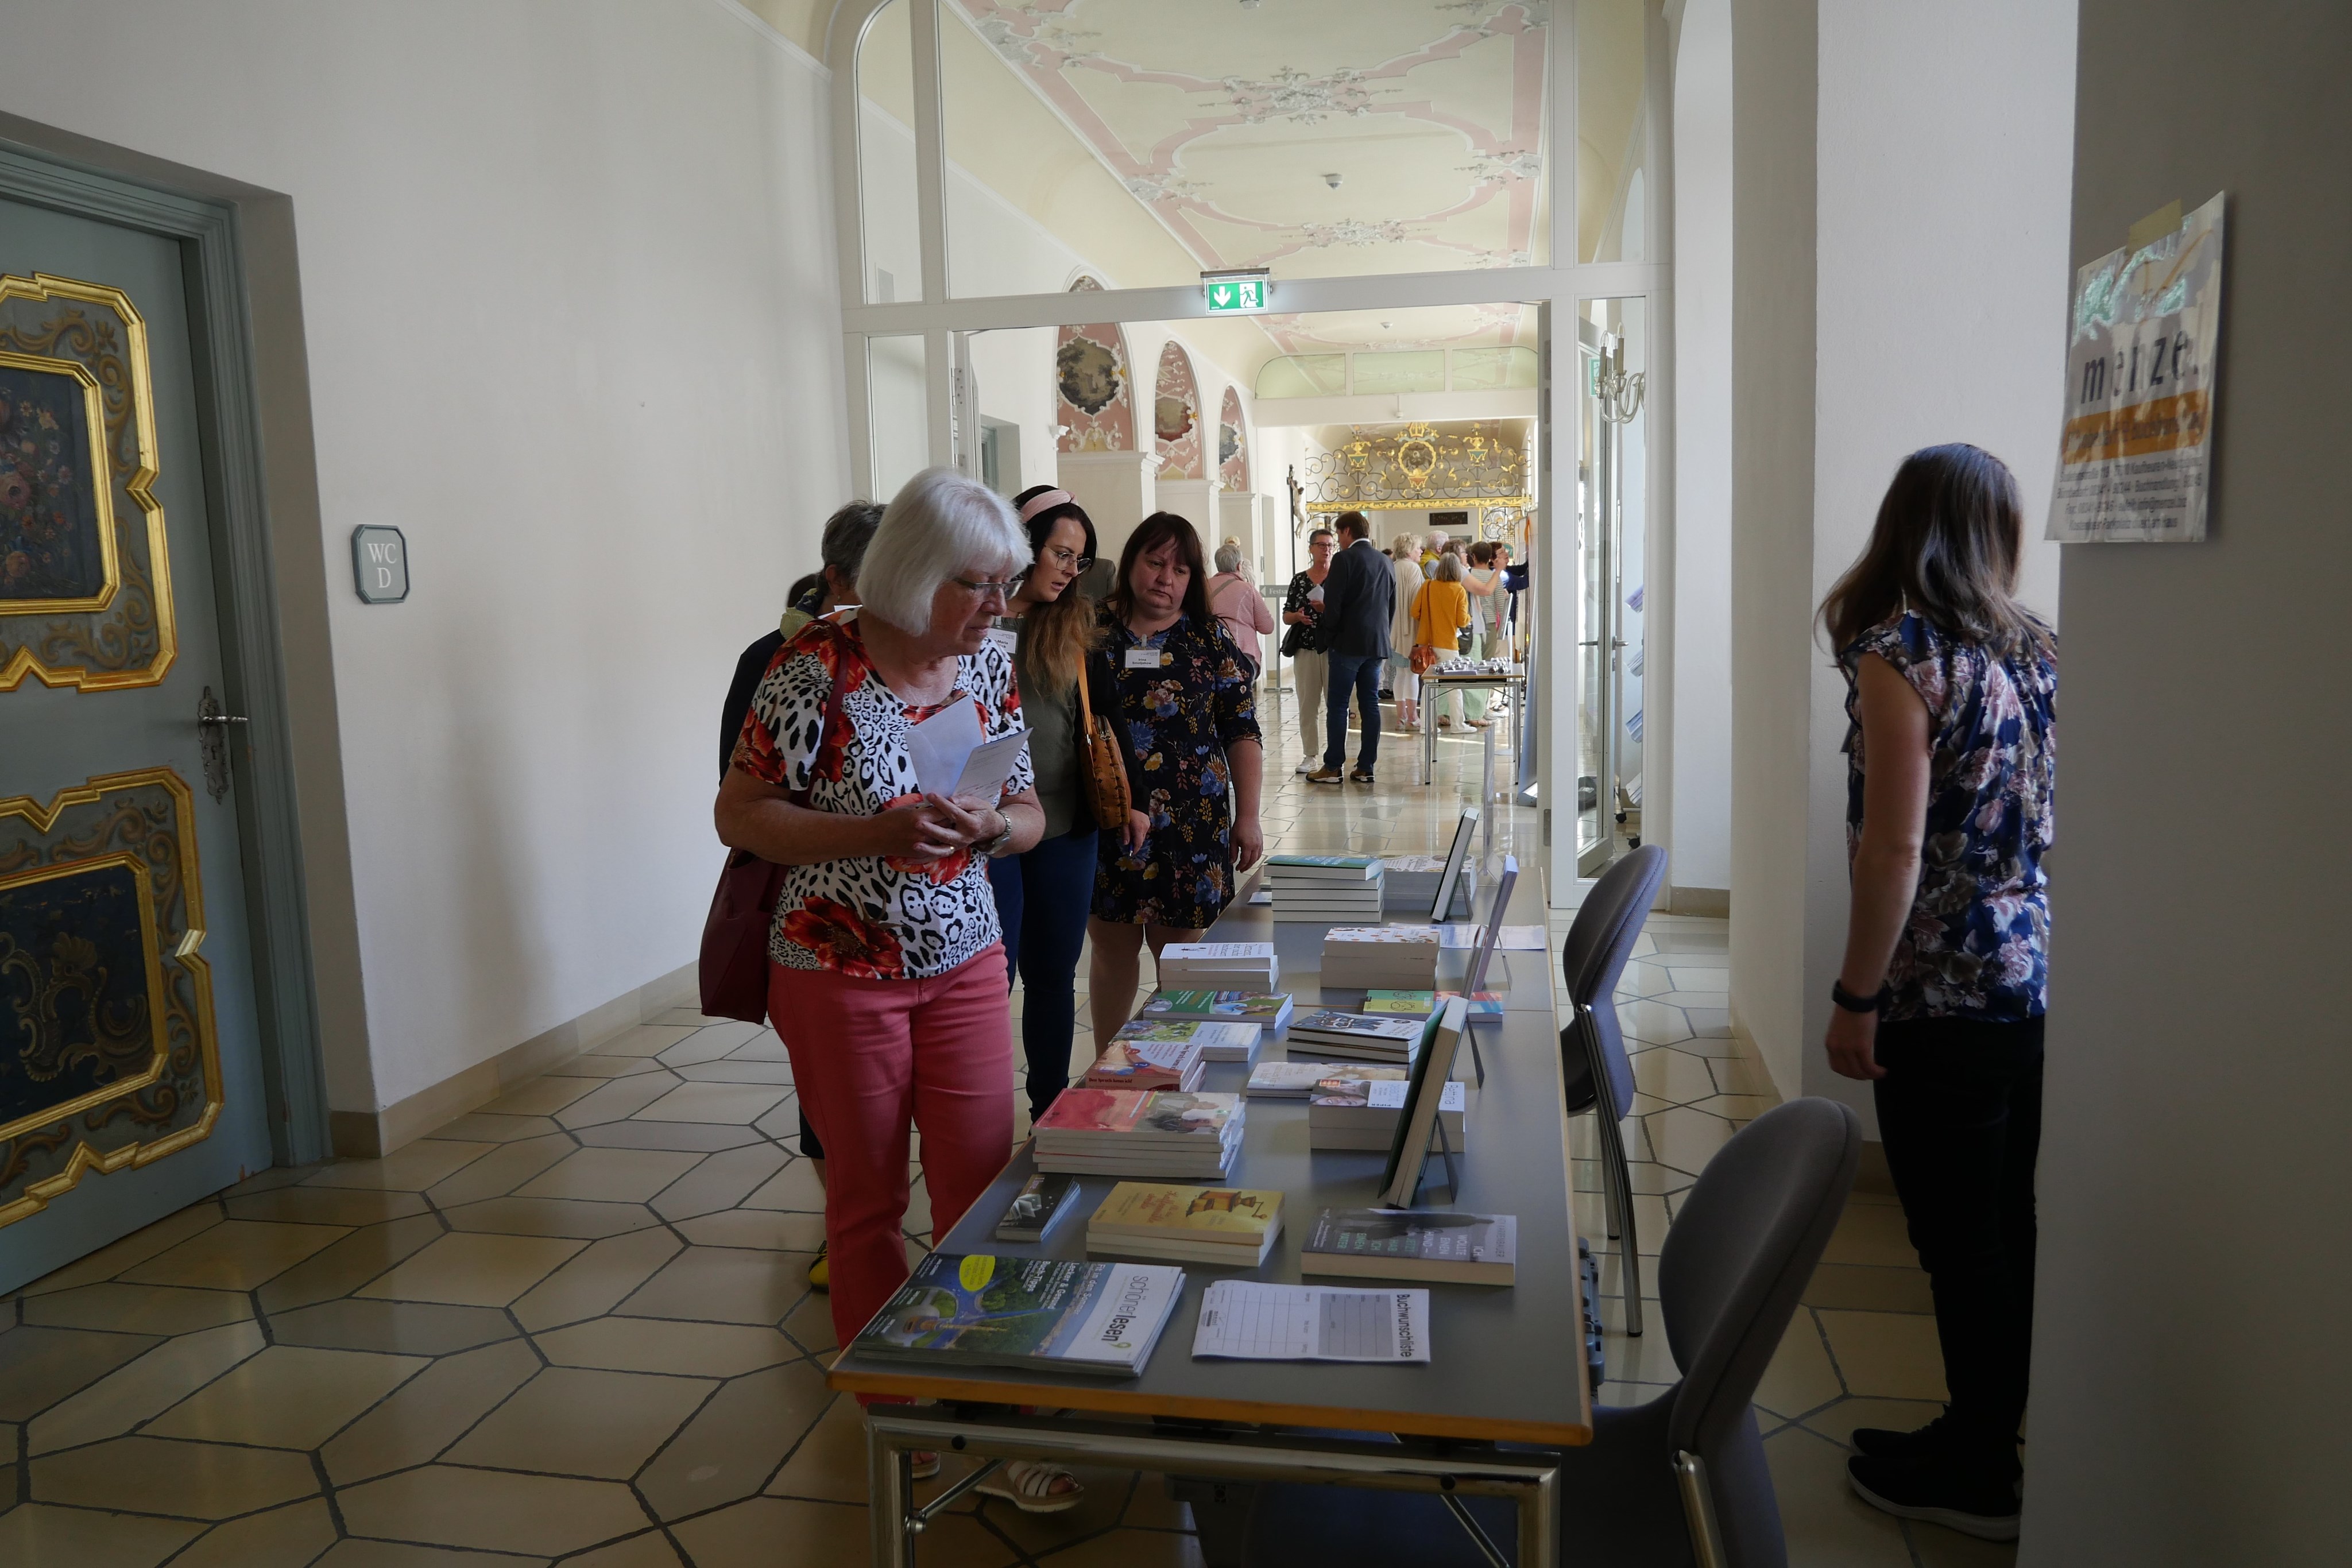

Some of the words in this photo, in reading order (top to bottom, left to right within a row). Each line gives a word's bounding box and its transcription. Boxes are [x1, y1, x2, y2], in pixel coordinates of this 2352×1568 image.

[2080, 329, 2199, 405] menze
[368, 543, 397, 564] WC
[377, 567, 390, 588] D
[1444, 1085, 1458, 1105] Bettina
[1335, 1232, 1351, 1249] VATER
[1421, 1231, 1436, 1246] HUND
[1437, 1237, 1451, 1255] EINEN
[1454, 1234, 1468, 1255] WOLLTE
[1471, 1245, 1484, 1256] ICH
[1027, 1261, 1051, 1291] Buch-Tipps
[1063, 1263, 1080, 1282] Lecker
[1087, 1280, 1098, 1291] den
[1050, 1290, 1066, 1310] Gesund
[1073, 1293, 1092, 1314] Sommer
[1102, 1276, 1150, 1342] schönerlesen
[1395, 1294, 1414, 1357] Buchwunschliste
